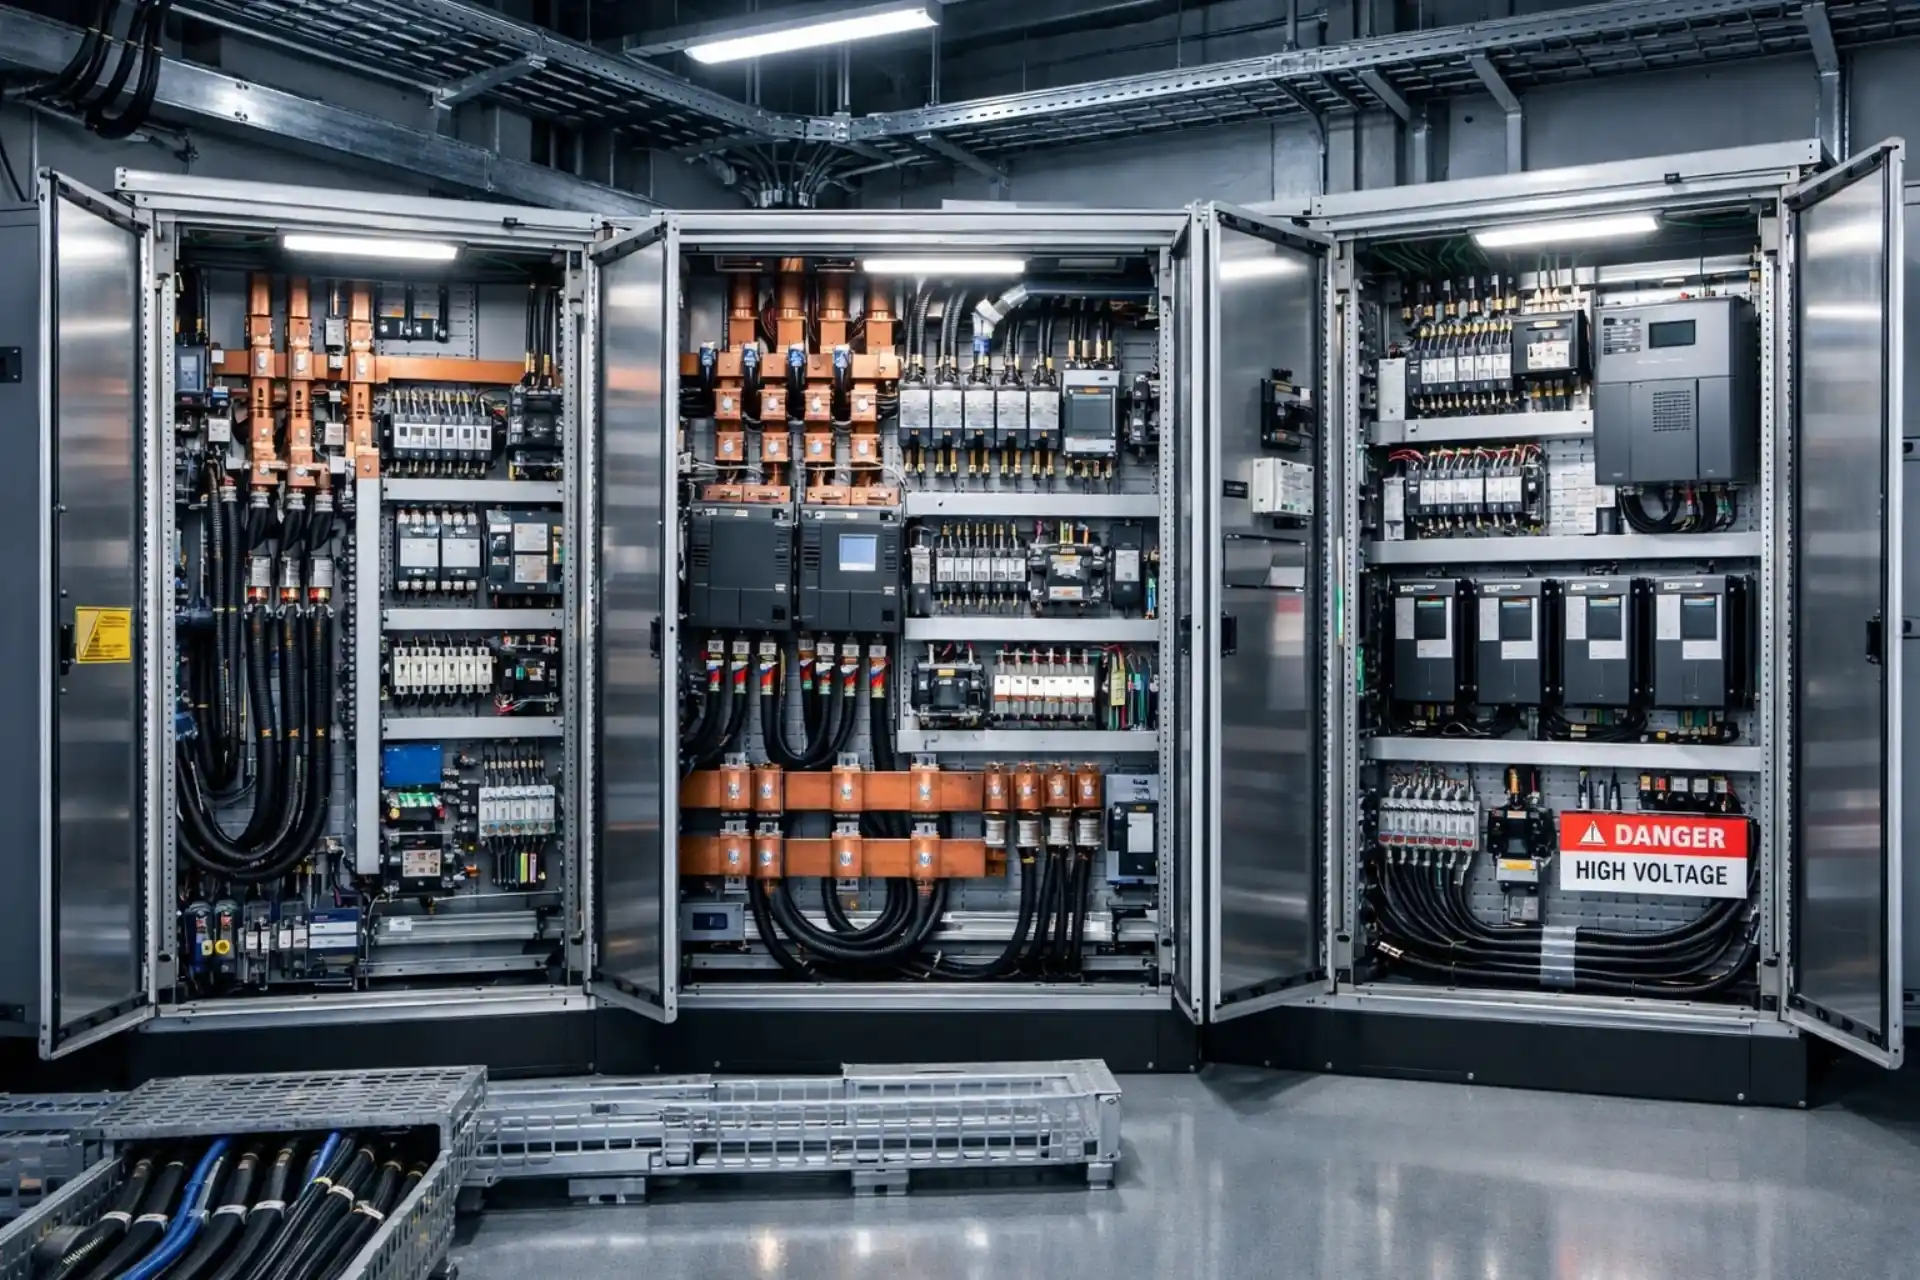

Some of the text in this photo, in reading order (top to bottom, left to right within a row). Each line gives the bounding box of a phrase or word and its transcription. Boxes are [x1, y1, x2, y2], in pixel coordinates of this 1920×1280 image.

[1615, 825, 1726, 849] DANGER
[1576, 860, 1728, 885] HIGH VOLTAGE
